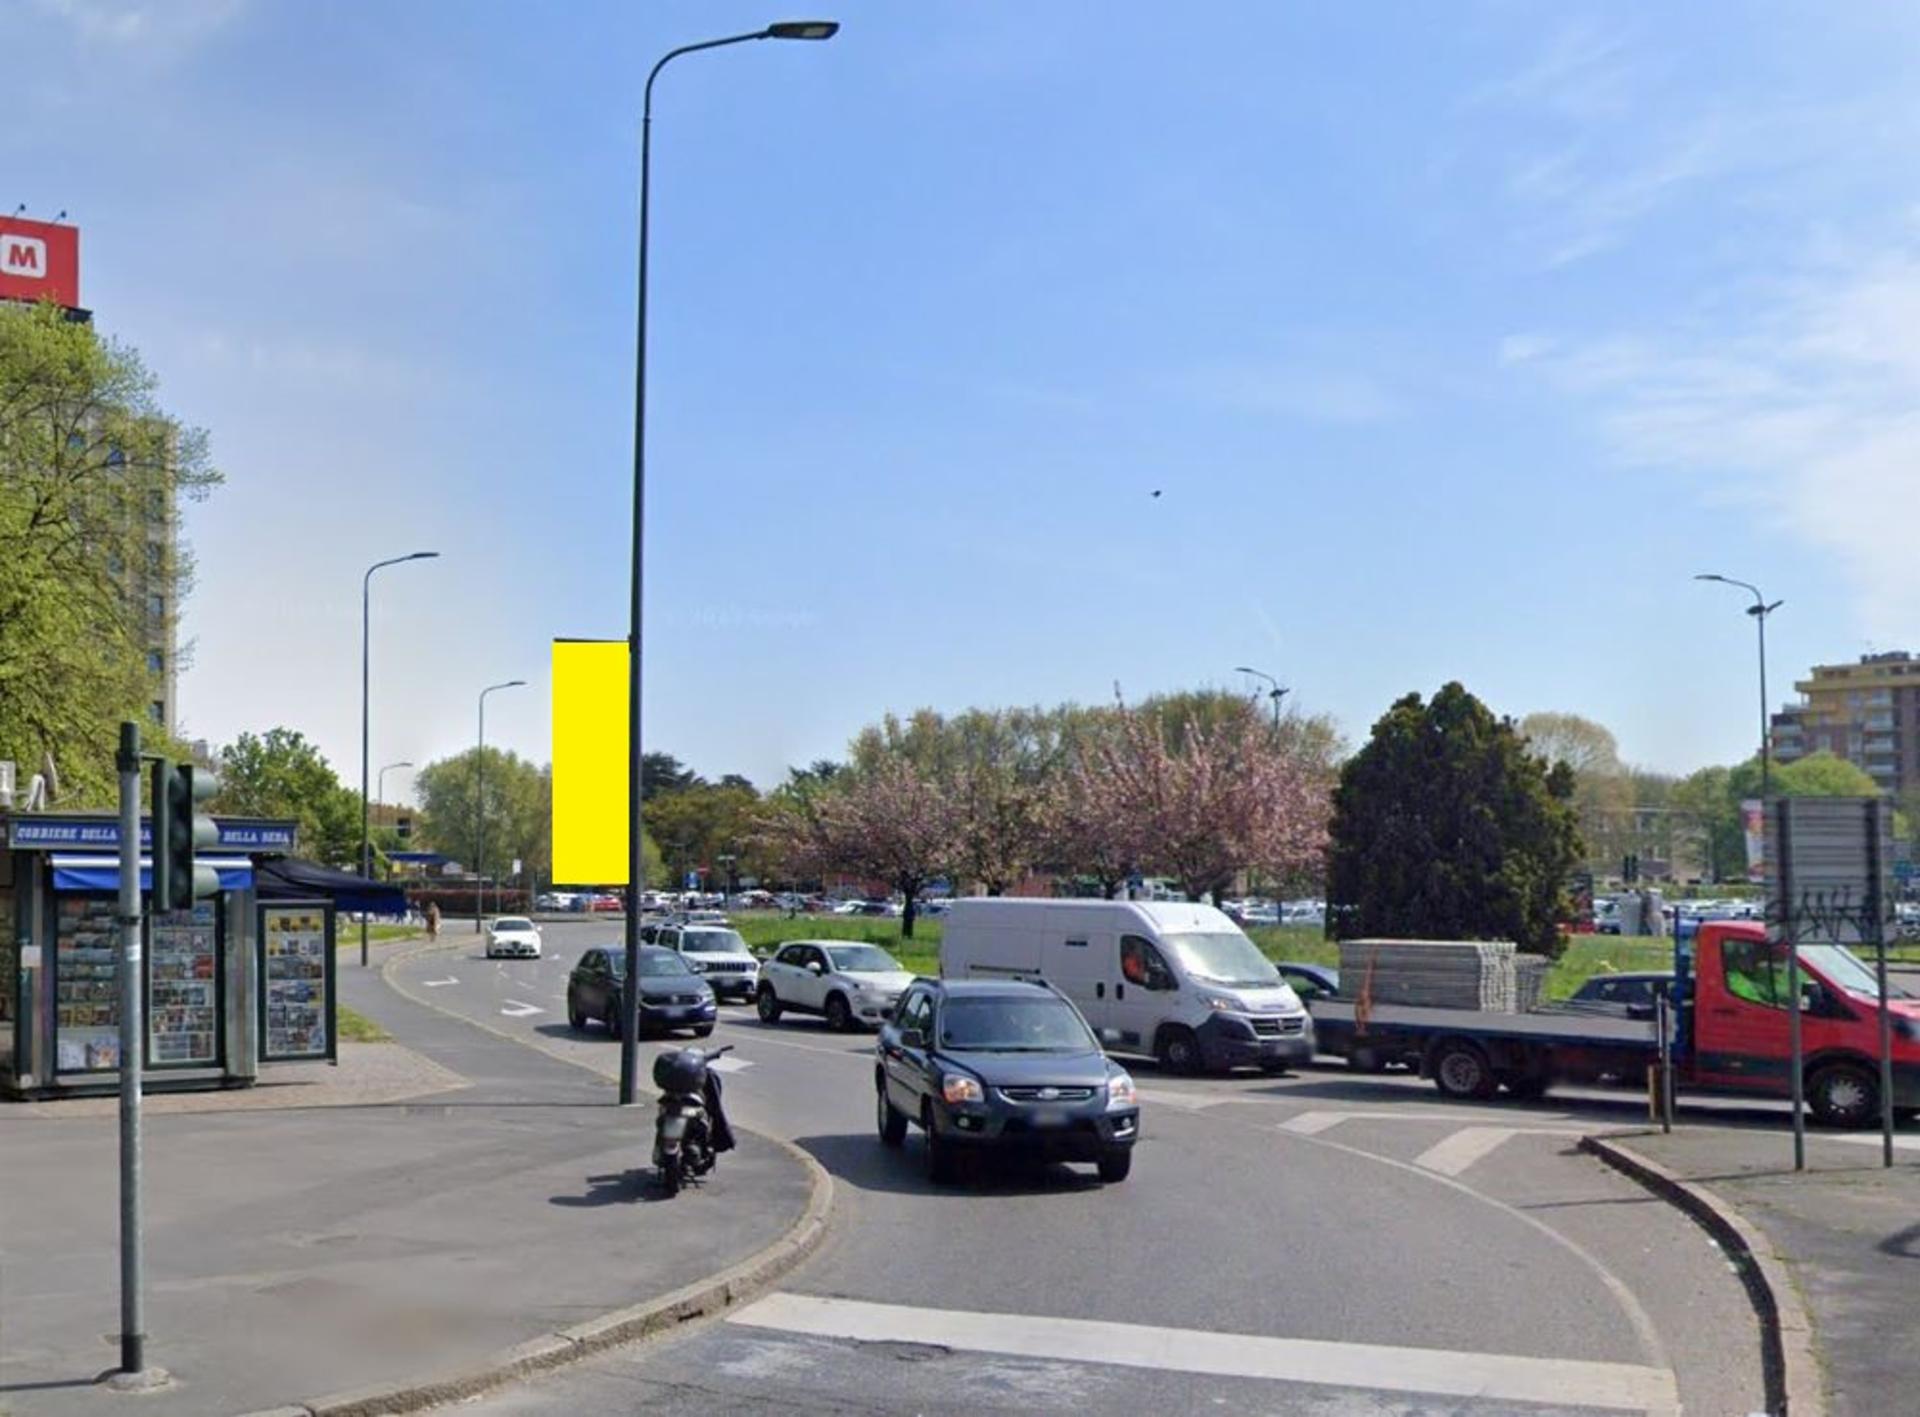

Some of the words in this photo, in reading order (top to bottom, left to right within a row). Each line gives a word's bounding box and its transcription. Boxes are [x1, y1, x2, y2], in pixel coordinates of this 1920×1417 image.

[9, 243, 38, 269] M
[17, 827, 78, 840] CORRIERE
[81, 828, 118, 840] DELLA
[223, 831, 258, 842] DELLA
